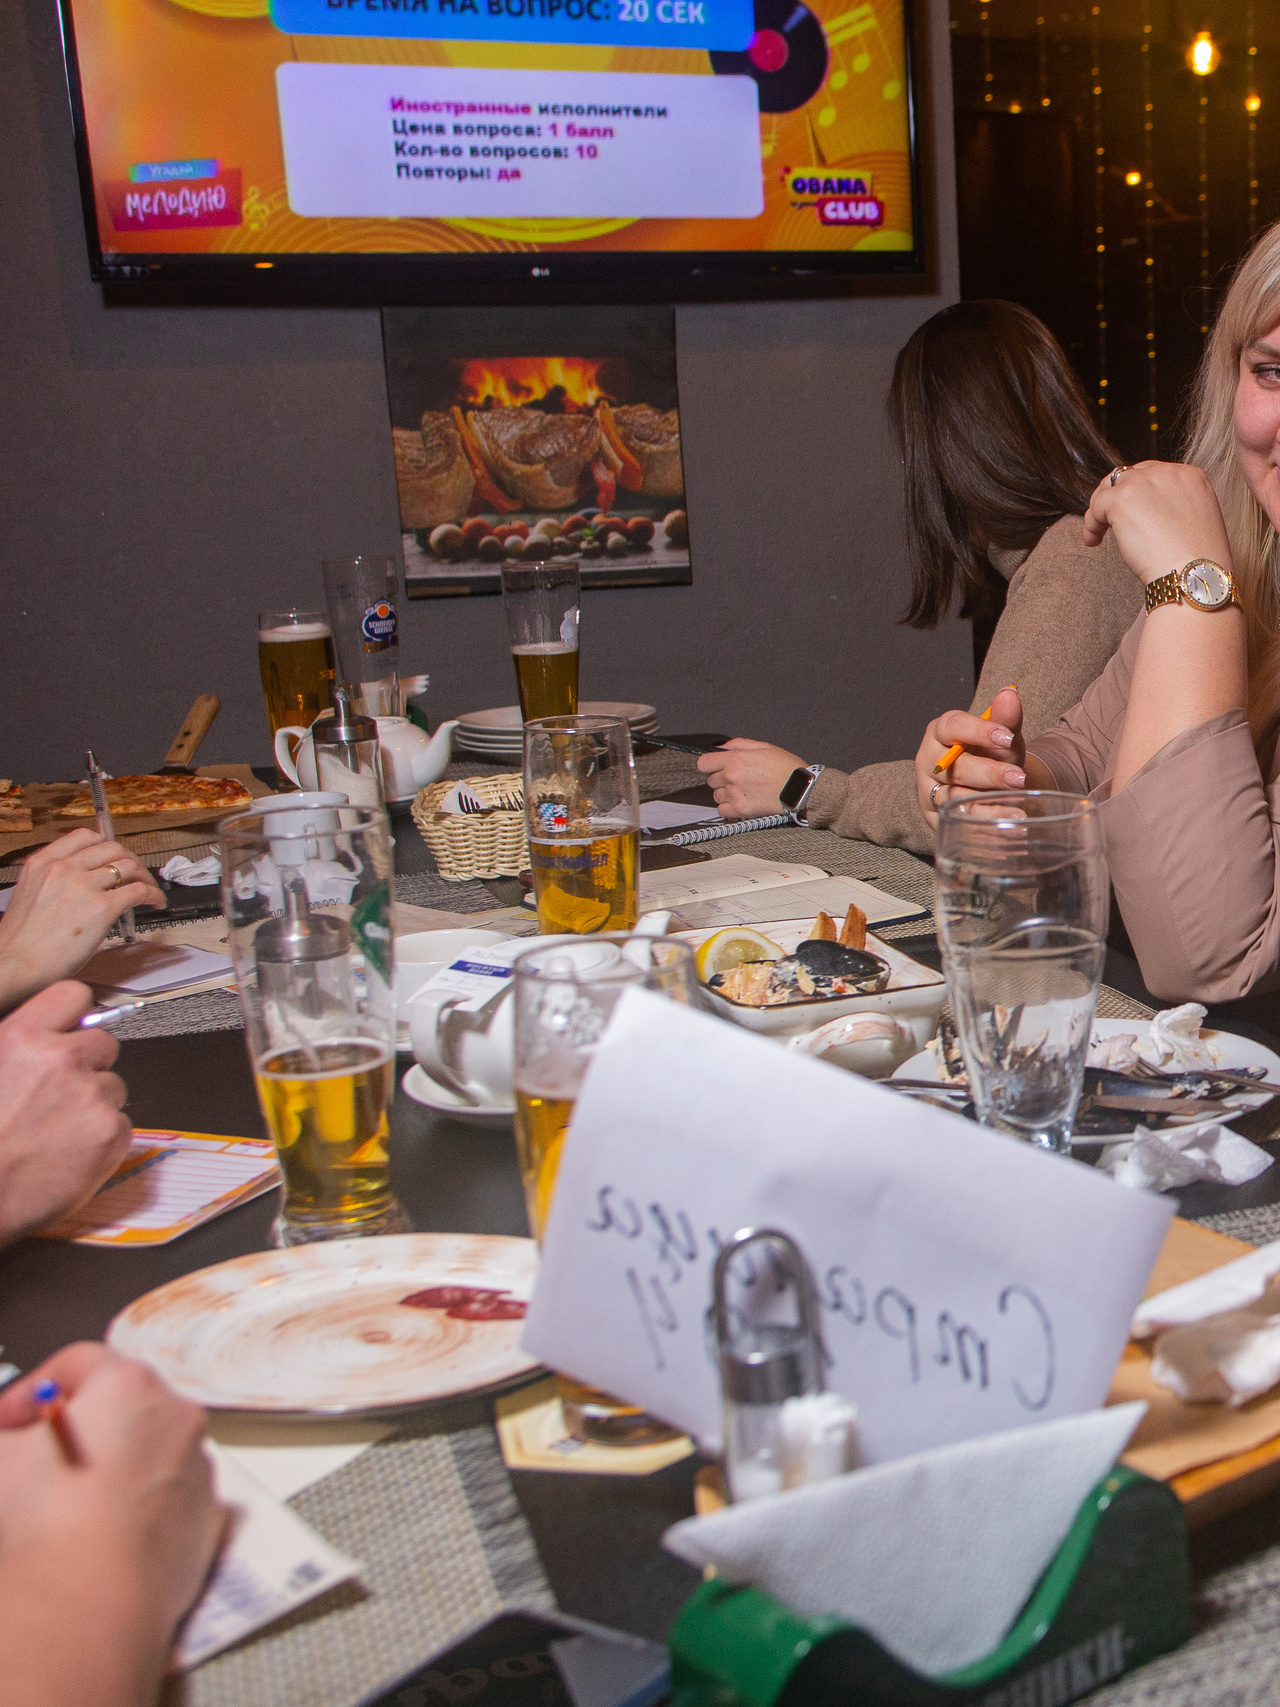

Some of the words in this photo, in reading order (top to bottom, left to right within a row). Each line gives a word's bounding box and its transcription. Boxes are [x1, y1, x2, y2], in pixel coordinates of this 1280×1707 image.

[438, 0, 479, 14] НА
[487, 0, 610, 20] ВОПРОС:
[617, 0, 649, 22] 20
[655, 1, 704, 24] СЕК
[390, 97, 531, 117] Иностранные
[538, 103, 668, 117] исполнители
[393, 119, 445, 138] Цена
[453, 123, 541, 138] вопроса:
[549, 123, 558, 137] 1
[566, 123, 615, 138] балл
[394, 141, 462, 157] Кол-во
[469, 144, 569, 160] вопросов:
[576, 145, 598, 158] 10
[396, 163, 491, 181] Повторы:
[497, 169, 522, 180] да
[792, 177, 867, 194] OBAMA
[823, 201, 879, 219] CLUB
